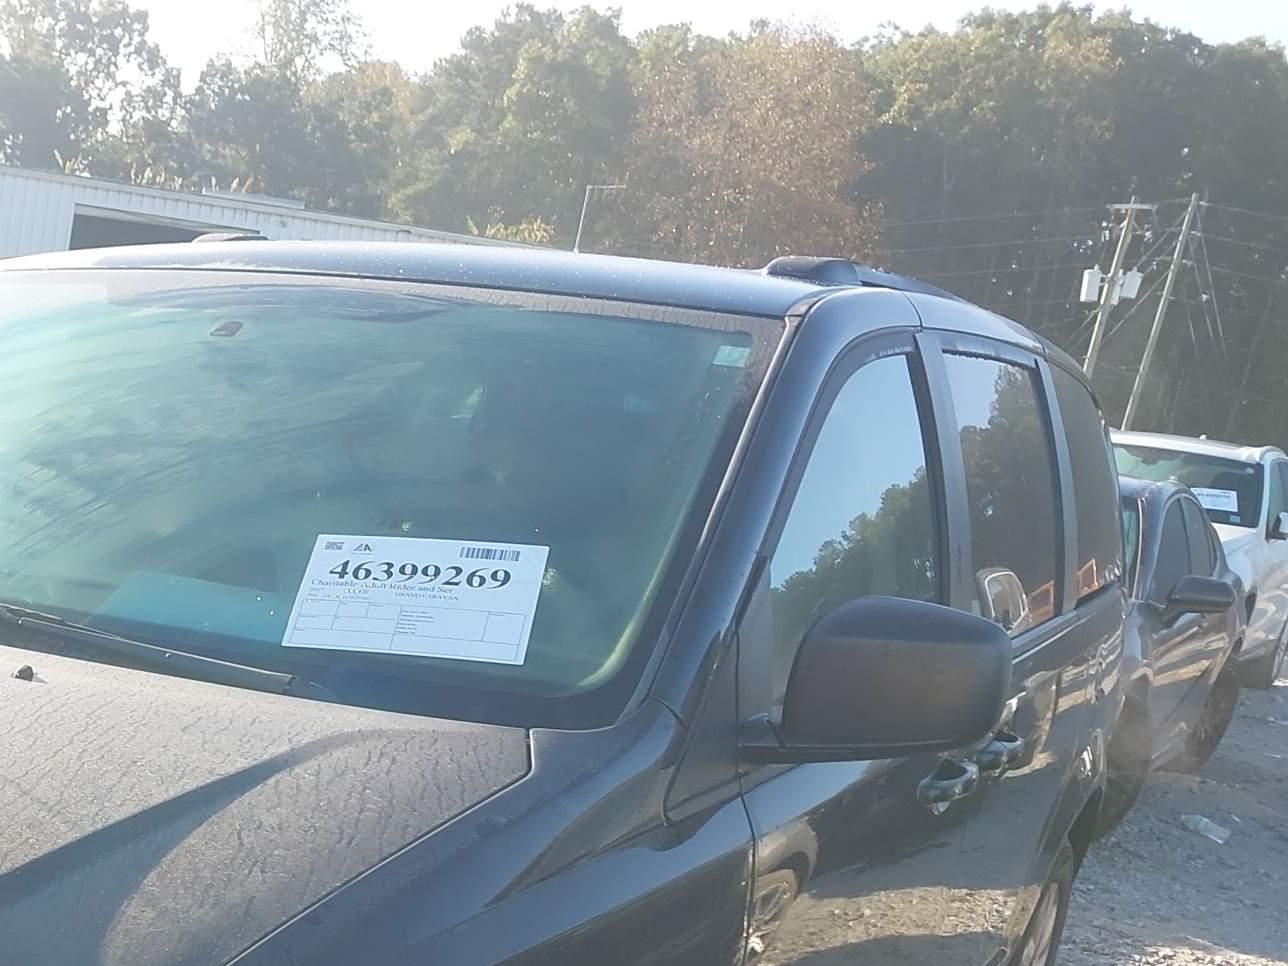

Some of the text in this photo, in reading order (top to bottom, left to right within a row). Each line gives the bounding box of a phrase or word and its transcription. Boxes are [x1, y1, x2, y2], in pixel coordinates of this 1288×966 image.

[329, 559, 512, 590] 46399269
[311, 579, 453, 594] Charitable Adult Rides and Ser
